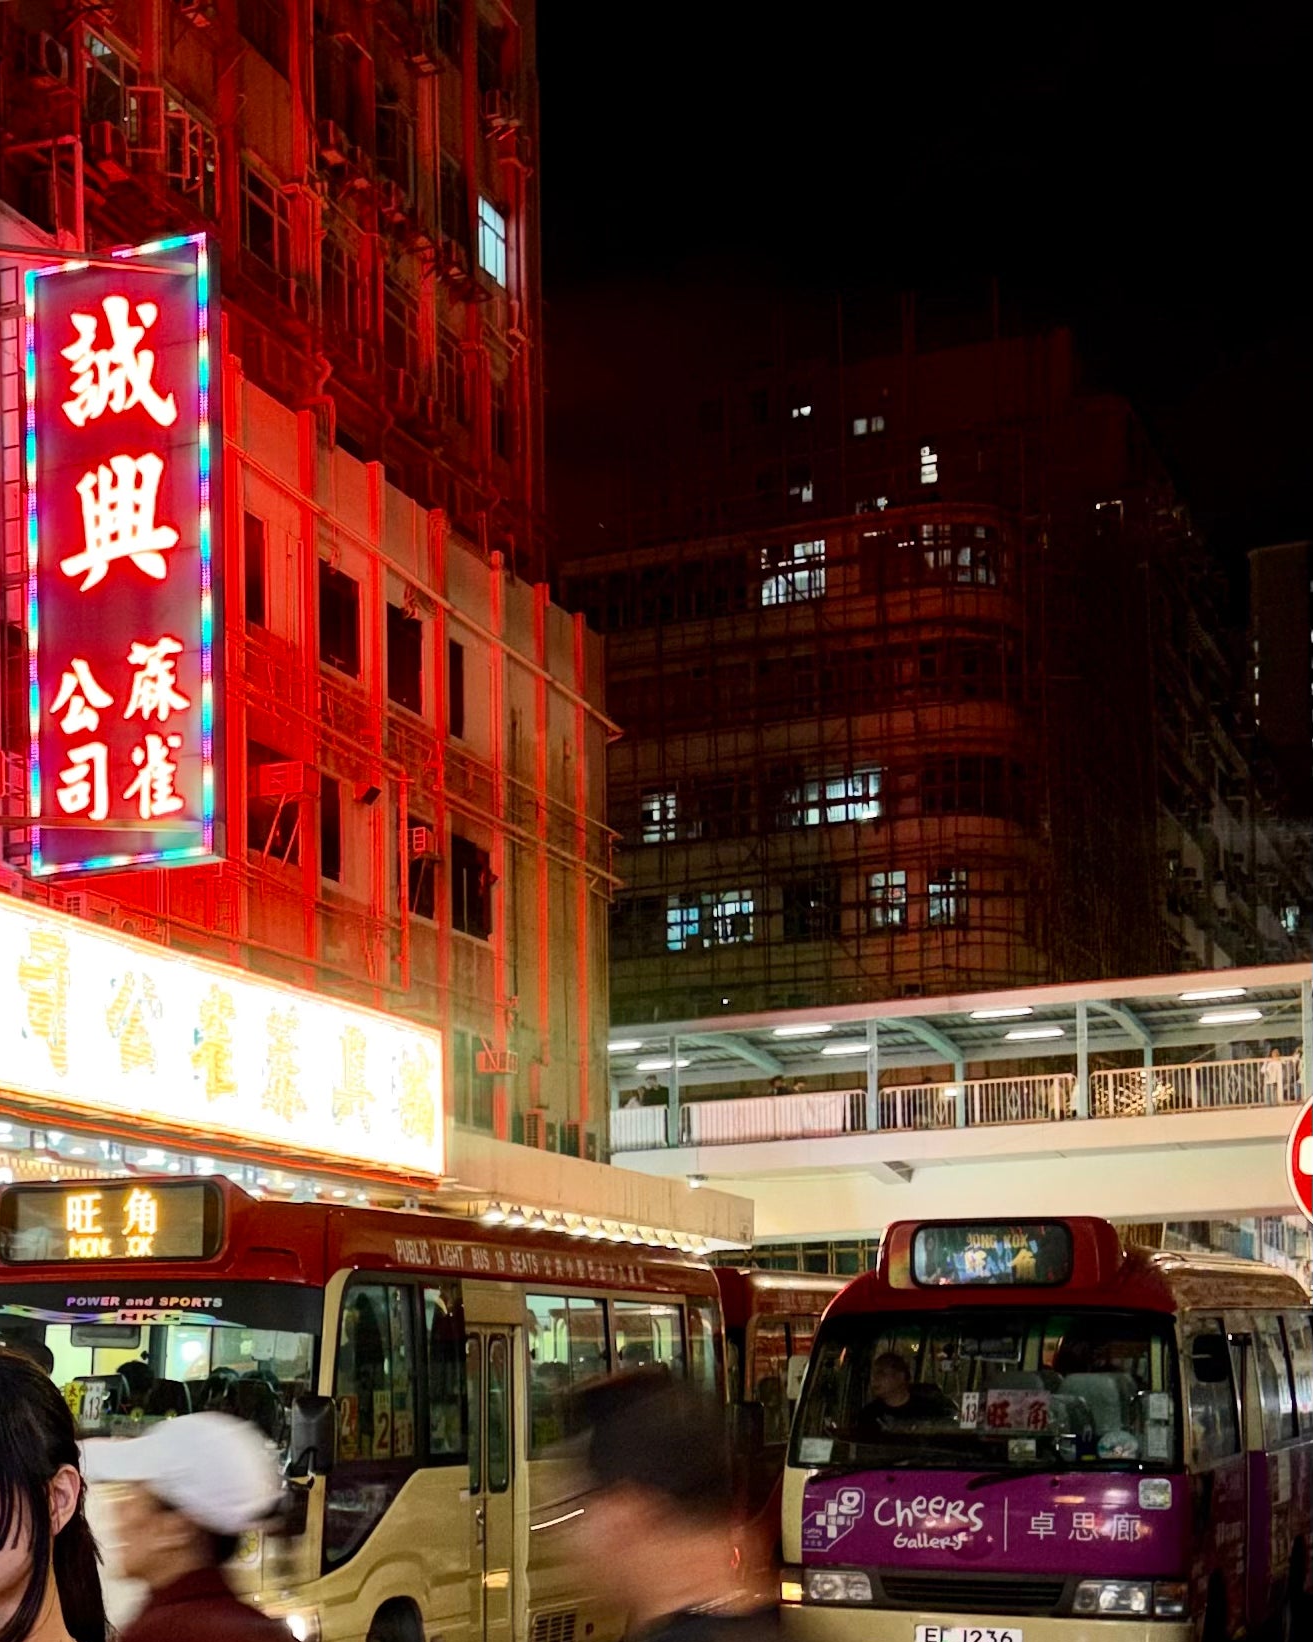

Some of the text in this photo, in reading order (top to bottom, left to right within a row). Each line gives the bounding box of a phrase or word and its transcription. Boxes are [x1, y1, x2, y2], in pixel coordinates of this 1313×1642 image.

[65, 1187, 158, 1236] 旺角
[394, 1239, 431, 1265] PUBLIC
[435, 1243, 464, 1268] LIGHT
[470, 1247, 490, 1270] BUS
[509, 1251, 539, 1275] SEATS
[66, 1296, 223, 1308] POWER and SPORTS
[1026, 1511, 1143, 1543] 卓思廊
